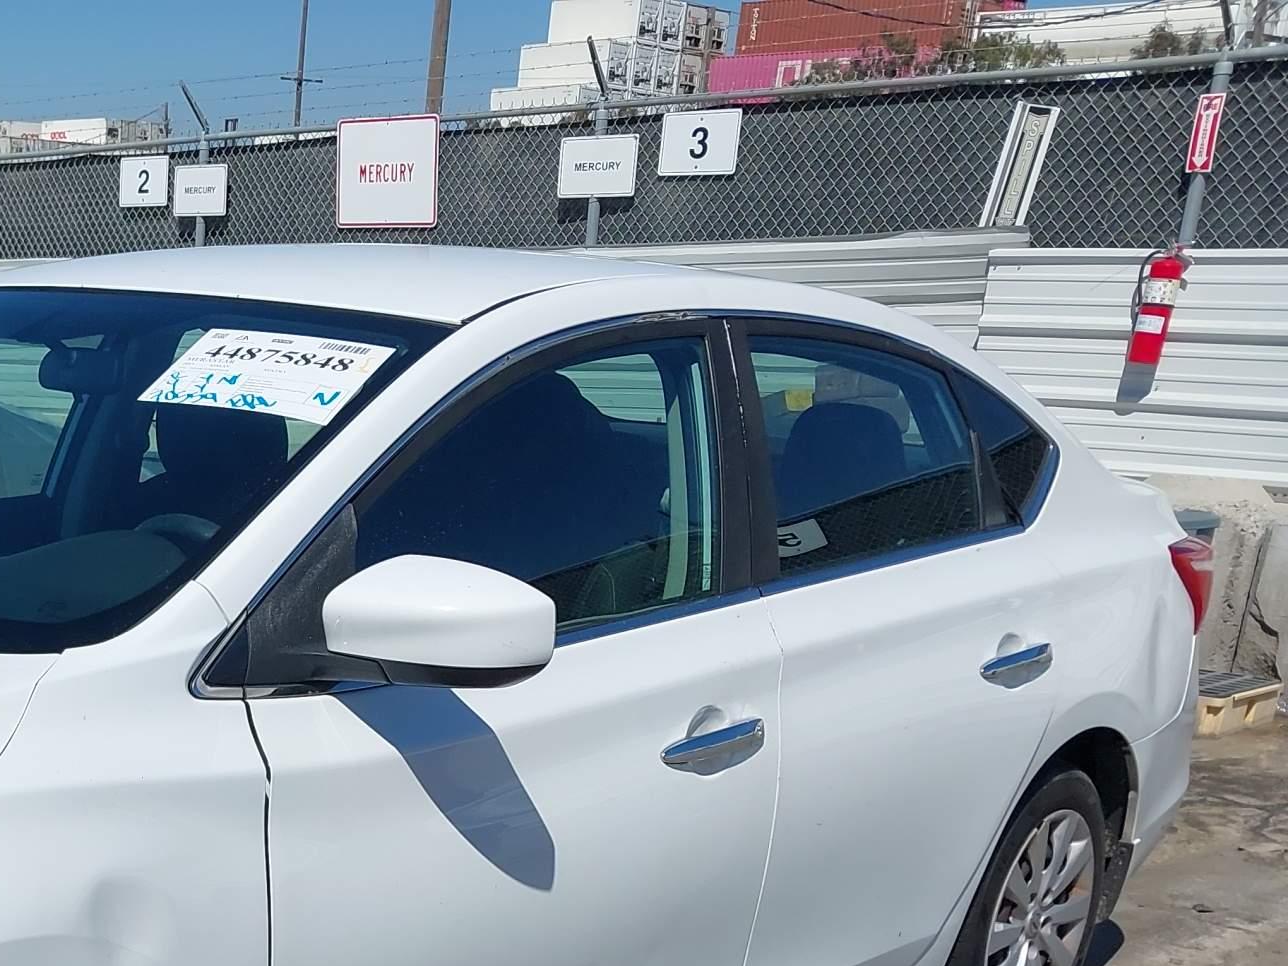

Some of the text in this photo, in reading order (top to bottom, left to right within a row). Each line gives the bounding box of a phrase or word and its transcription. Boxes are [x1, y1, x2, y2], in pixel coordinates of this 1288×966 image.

[689, 127, 709, 160] 3
[359, 162, 415, 184] MERCURY
[574, 161, 622, 172] MERCURY
[1004, 120, 1040, 215] SPILL
[137, 169, 150, 194] 2
[184, 186, 217, 195] MERCURY
[204, 344, 355, 373] 44875848
